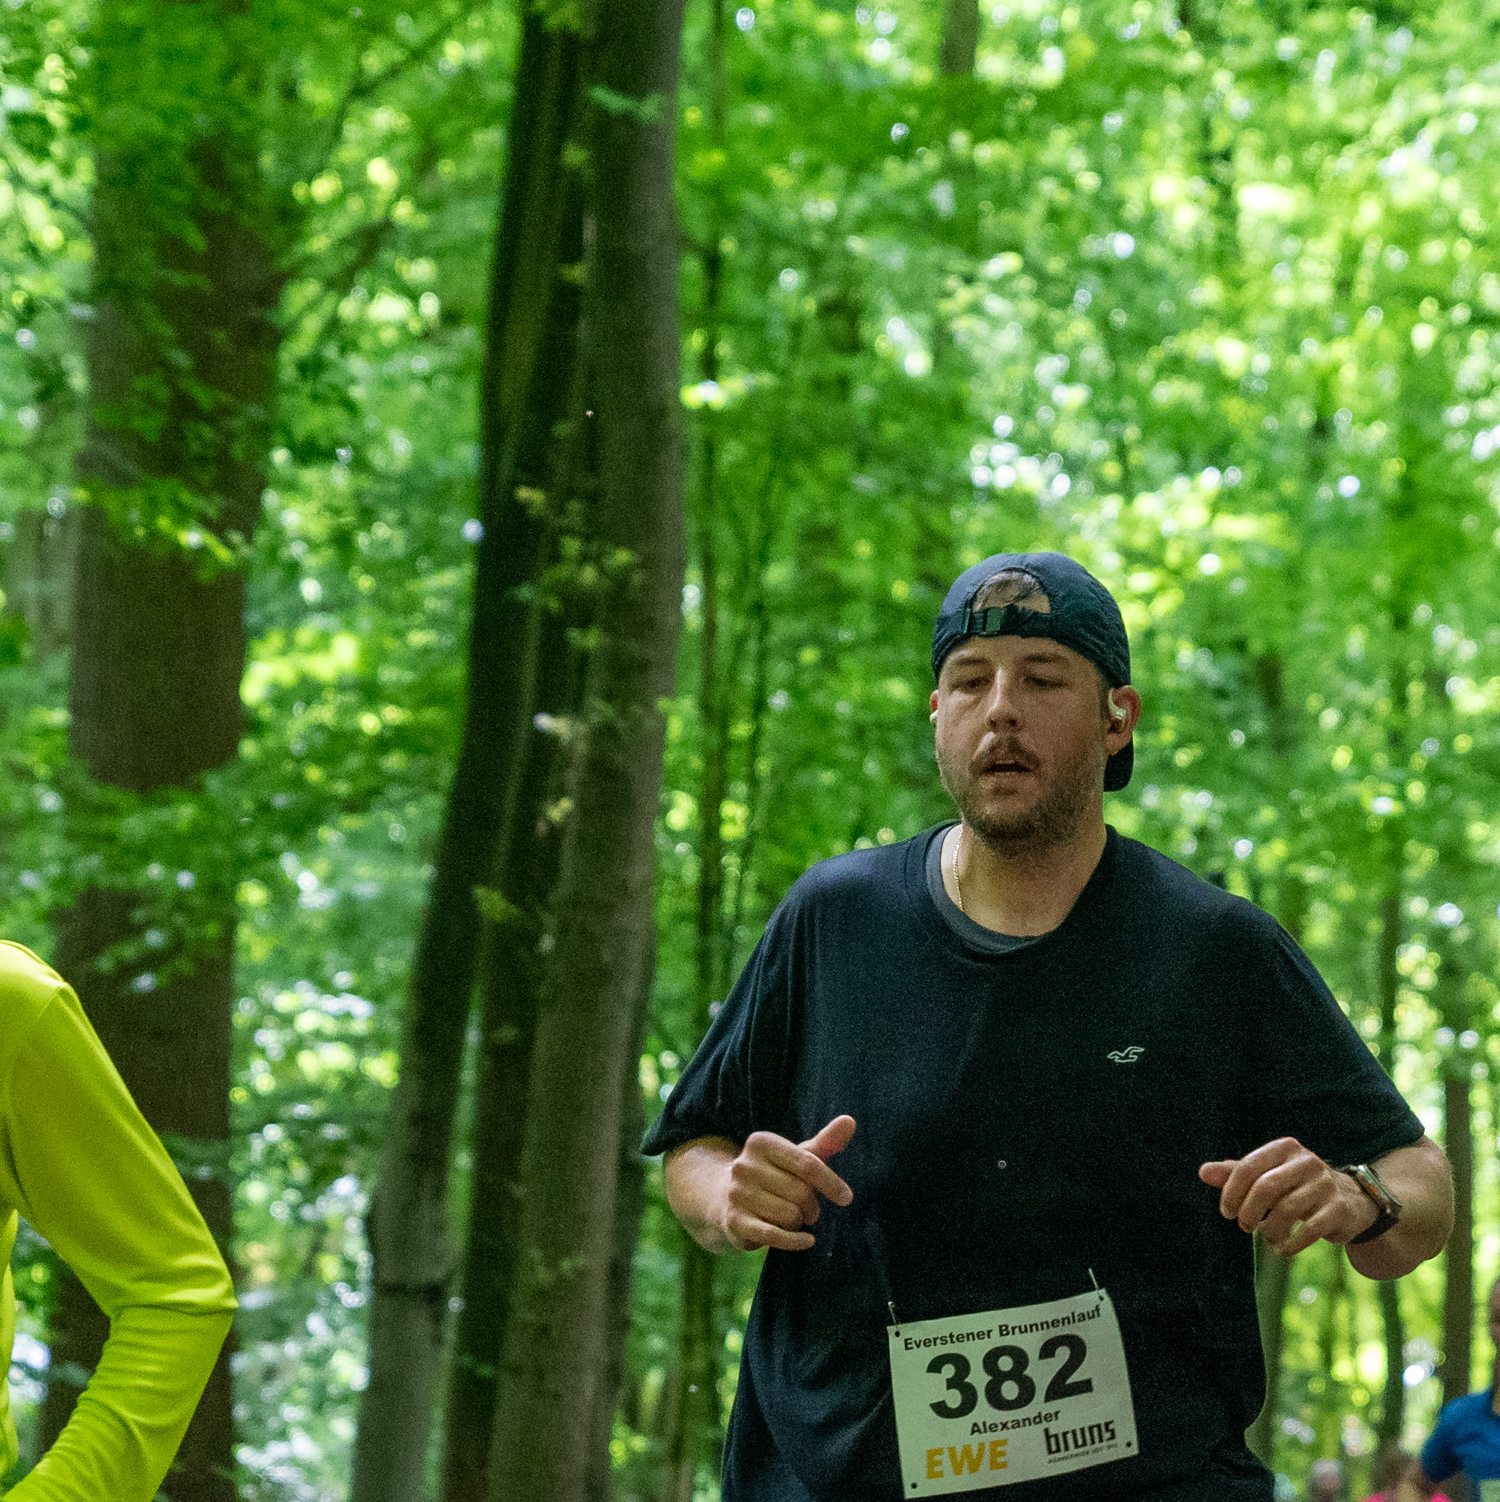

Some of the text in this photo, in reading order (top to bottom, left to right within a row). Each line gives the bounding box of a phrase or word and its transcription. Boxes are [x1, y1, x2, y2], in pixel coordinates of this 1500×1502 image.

[903, 1304, 1102, 1351] Everstener Brunnenlauf
[925, 1333, 1094, 1420] 382
[969, 1409, 1062, 1436] Alexander
[1043, 1418, 1117, 1456] bruns
[925, 1438, 1009, 1480] EWE
